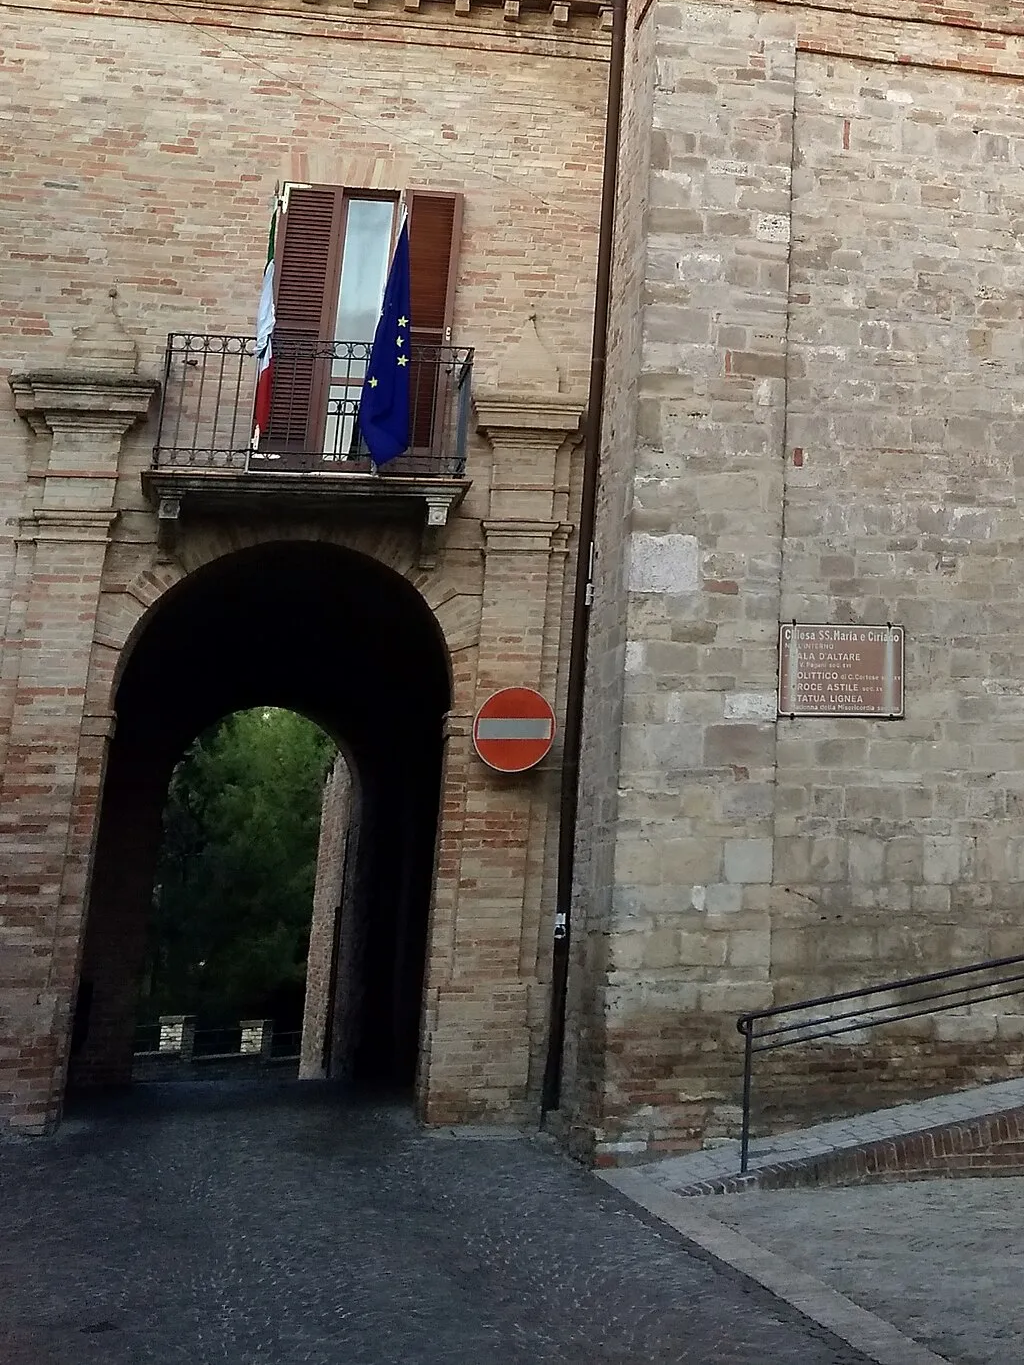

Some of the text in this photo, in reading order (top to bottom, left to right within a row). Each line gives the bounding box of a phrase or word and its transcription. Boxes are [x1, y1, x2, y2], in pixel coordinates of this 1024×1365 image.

[860, 633, 866, 642] e
[792, 652, 861, 662] ALA D'ALTARE
[792, 671, 839, 680] OLITTICO
[792, 682, 823, 692] ROCE
[826, 683, 859, 692] ASTILE
[829, 694, 864, 704] LIGNEA
